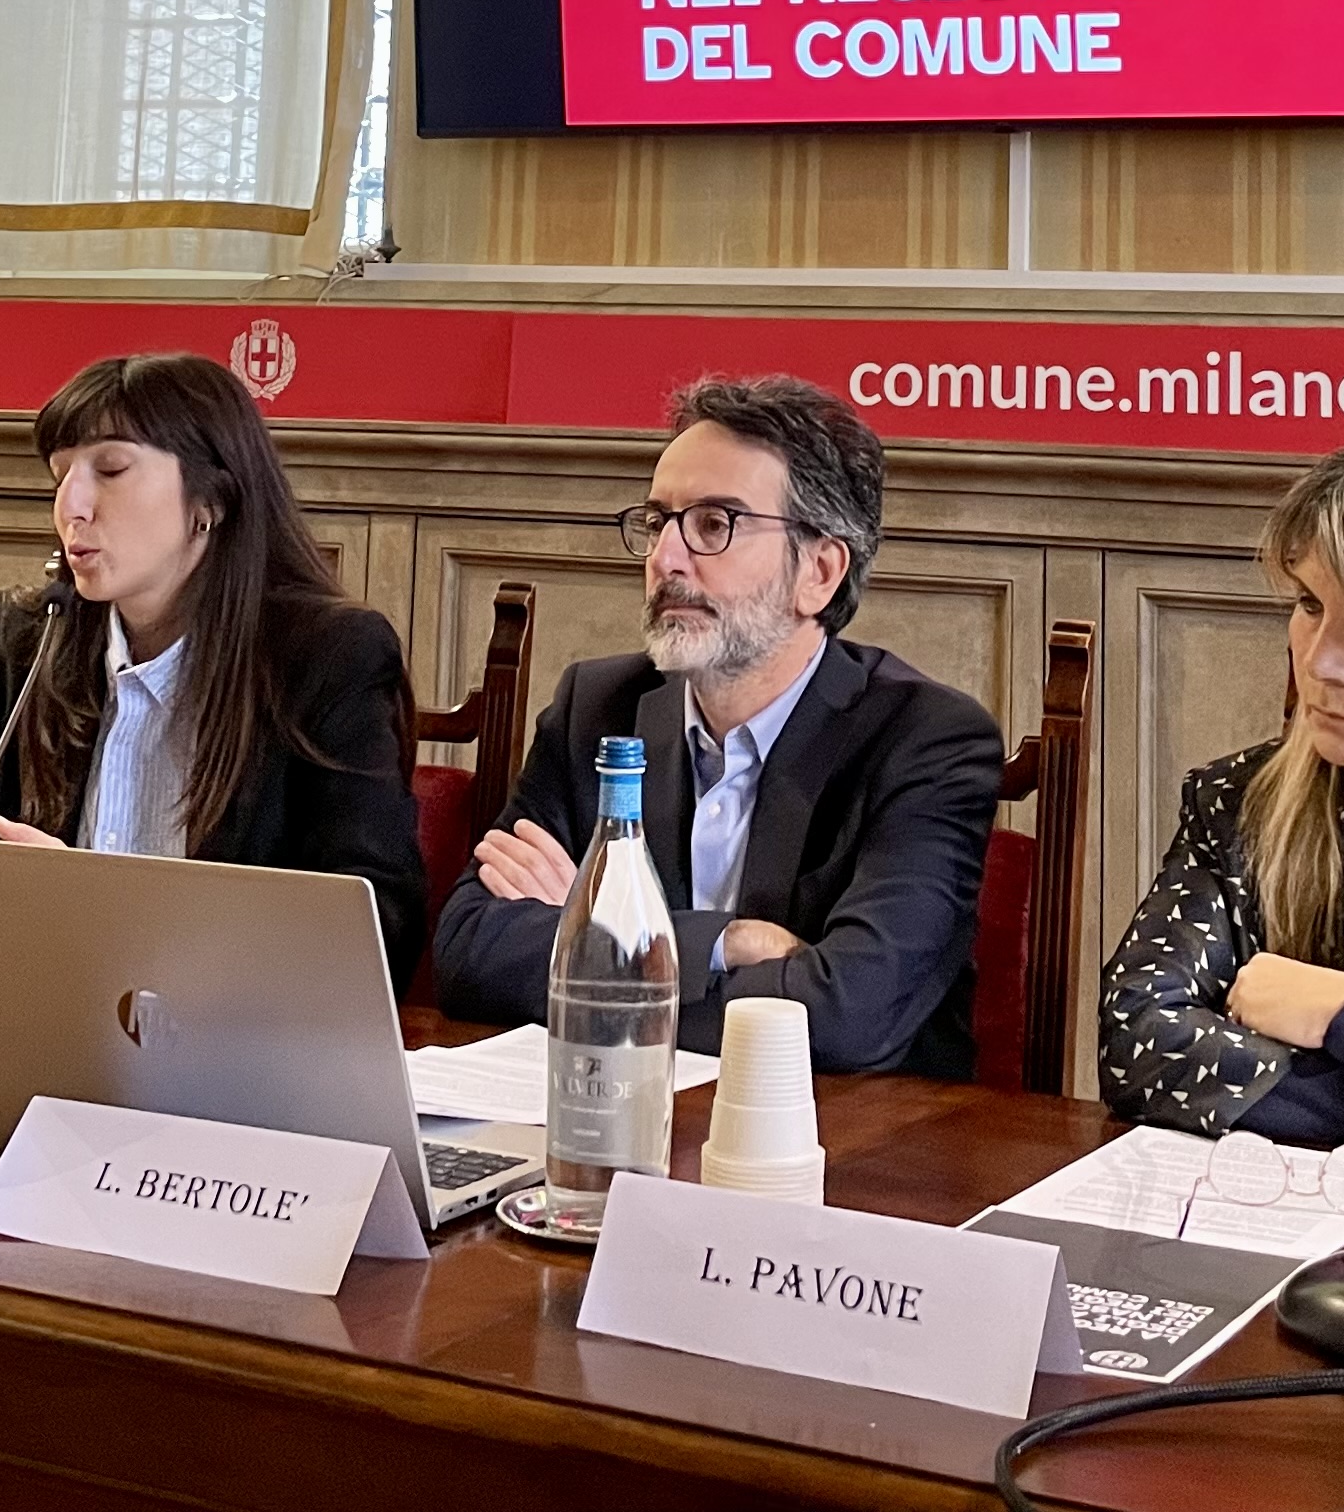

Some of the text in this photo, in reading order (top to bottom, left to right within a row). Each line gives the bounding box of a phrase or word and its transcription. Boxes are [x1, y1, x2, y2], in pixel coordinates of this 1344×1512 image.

[642, 13, 1122, 82] DEL COMUNE
[93, 1161, 121, 1194] L.
[699, 1246, 924, 1324] L. PAVONE
